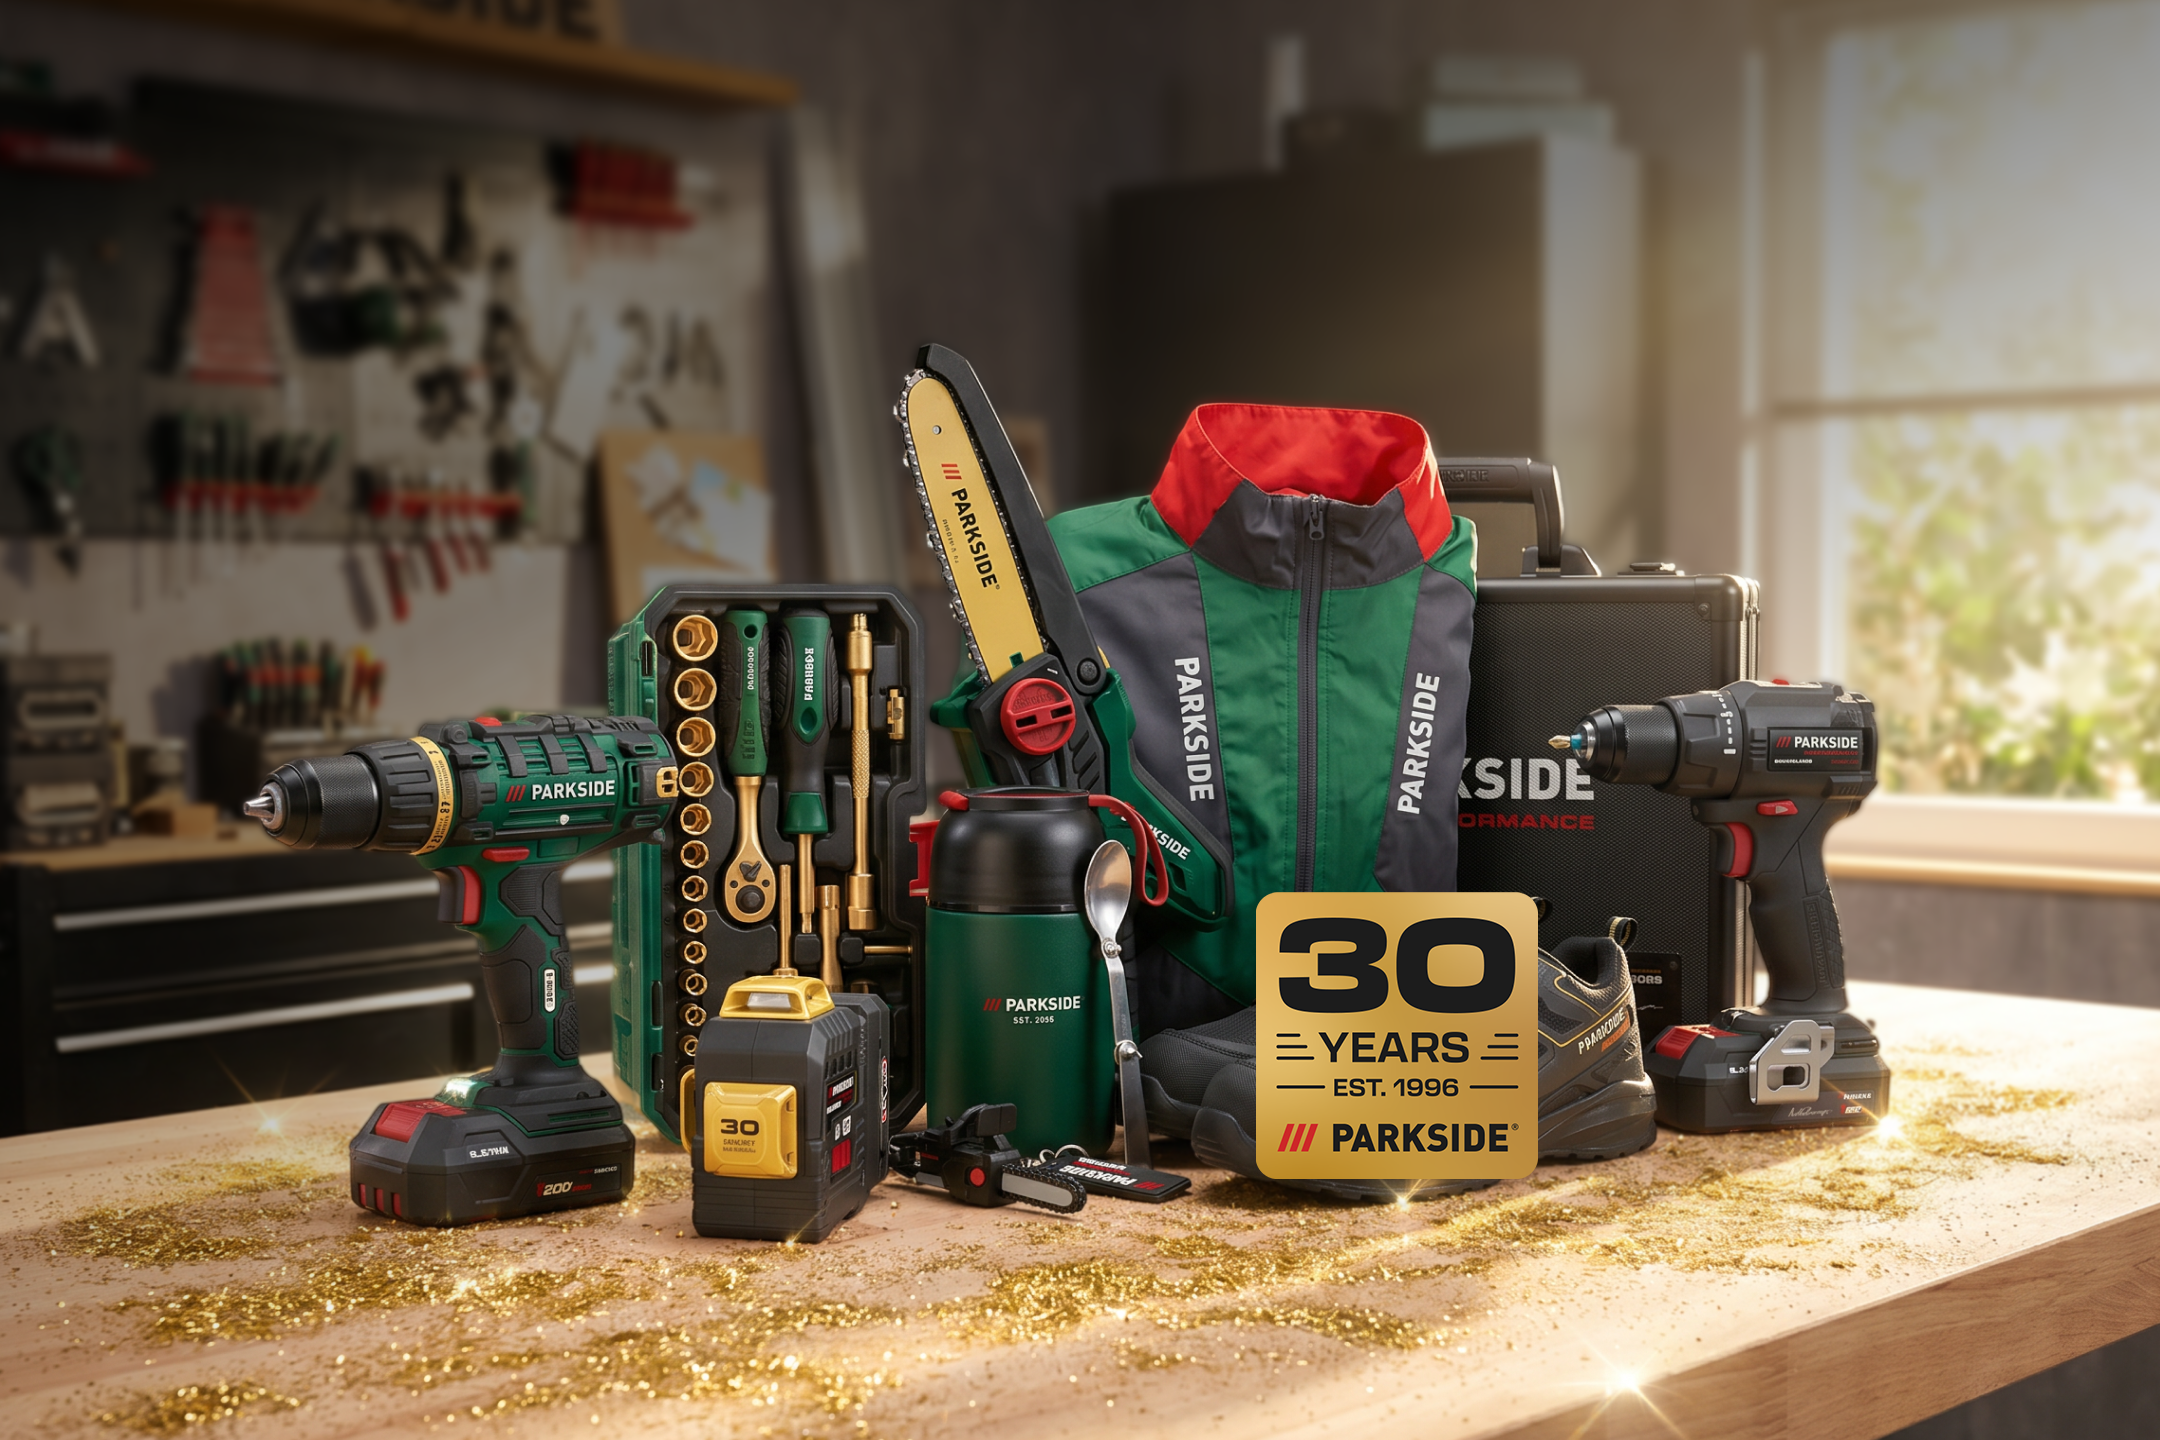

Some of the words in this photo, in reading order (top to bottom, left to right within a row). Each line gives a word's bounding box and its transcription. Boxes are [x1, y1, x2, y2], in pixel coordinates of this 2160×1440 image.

[951, 488, 997, 588] PARKSIDE
[1174, 657, 1215, 802] PARKSIDE
[1397, 672, 1440, 815] PARKSIDE
[1794, 736, 1859, 749] PARKSIDE
[531, 780, 616, 800] PARKSIDE
[1148, 824, 1191, 860] KSIDE
[1006, 996, 1081, 1012] PARKSIDE
[720, 1118, 760, 1136] 30
